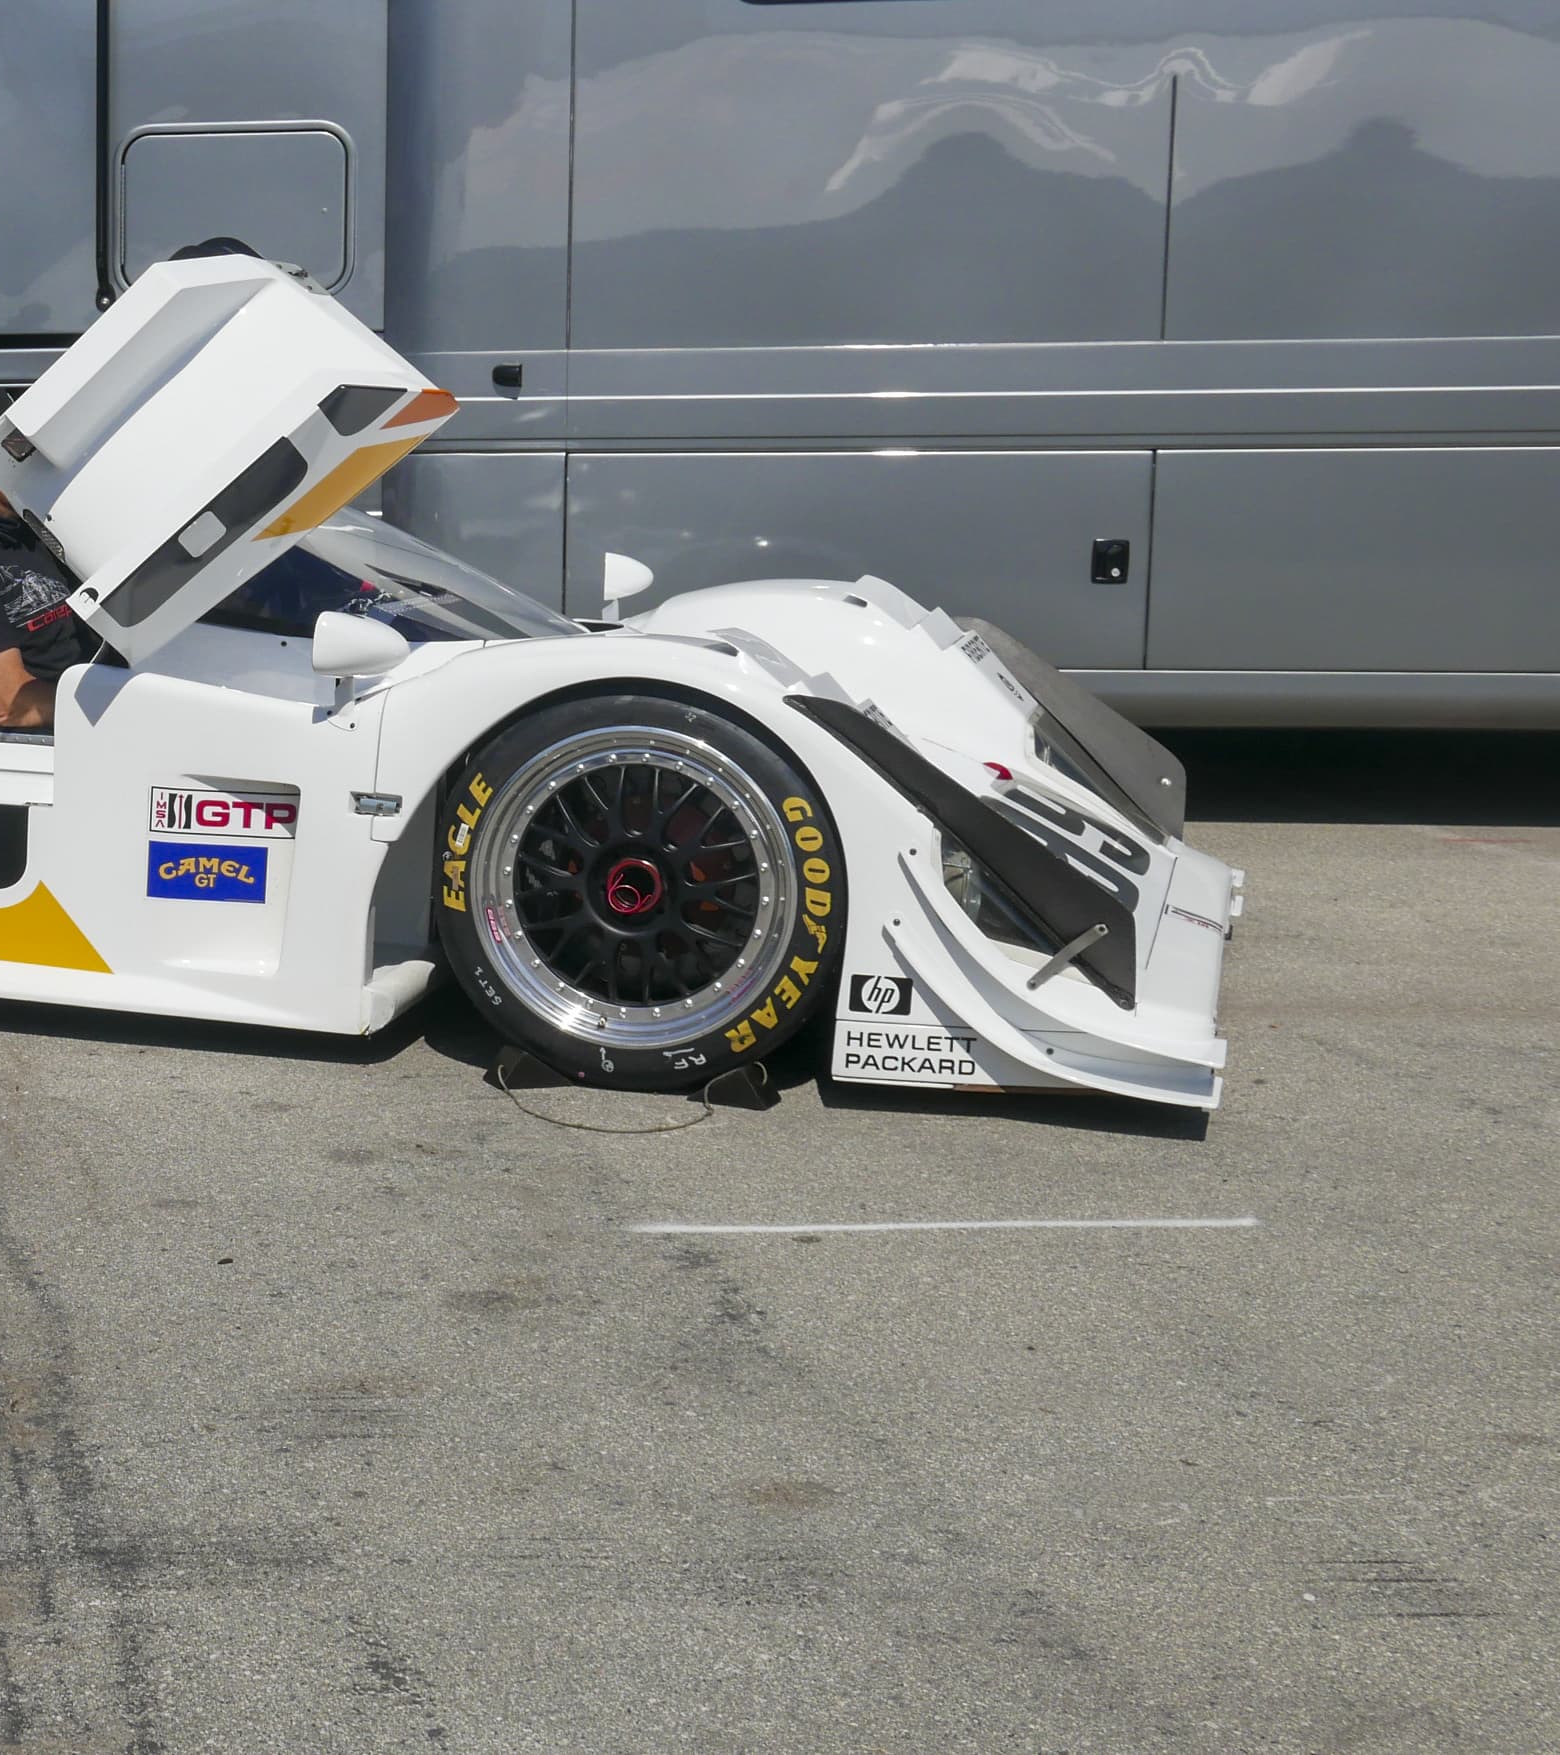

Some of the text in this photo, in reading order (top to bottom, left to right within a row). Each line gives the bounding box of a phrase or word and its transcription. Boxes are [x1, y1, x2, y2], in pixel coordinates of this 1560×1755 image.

[196, 799, 297, 830] GTP
[444, 772, 493, 912] EAGLE
[158, 857, 255, 885] CAMEL
[194, 874, 217, 888] GT
[866, 975, 896, 1014] hp
[846, 1031, 977, 1053] HEWLETT
[674, 1053, 707, 1070] RF
[845, 1053, 976, 1075] PACKARD
